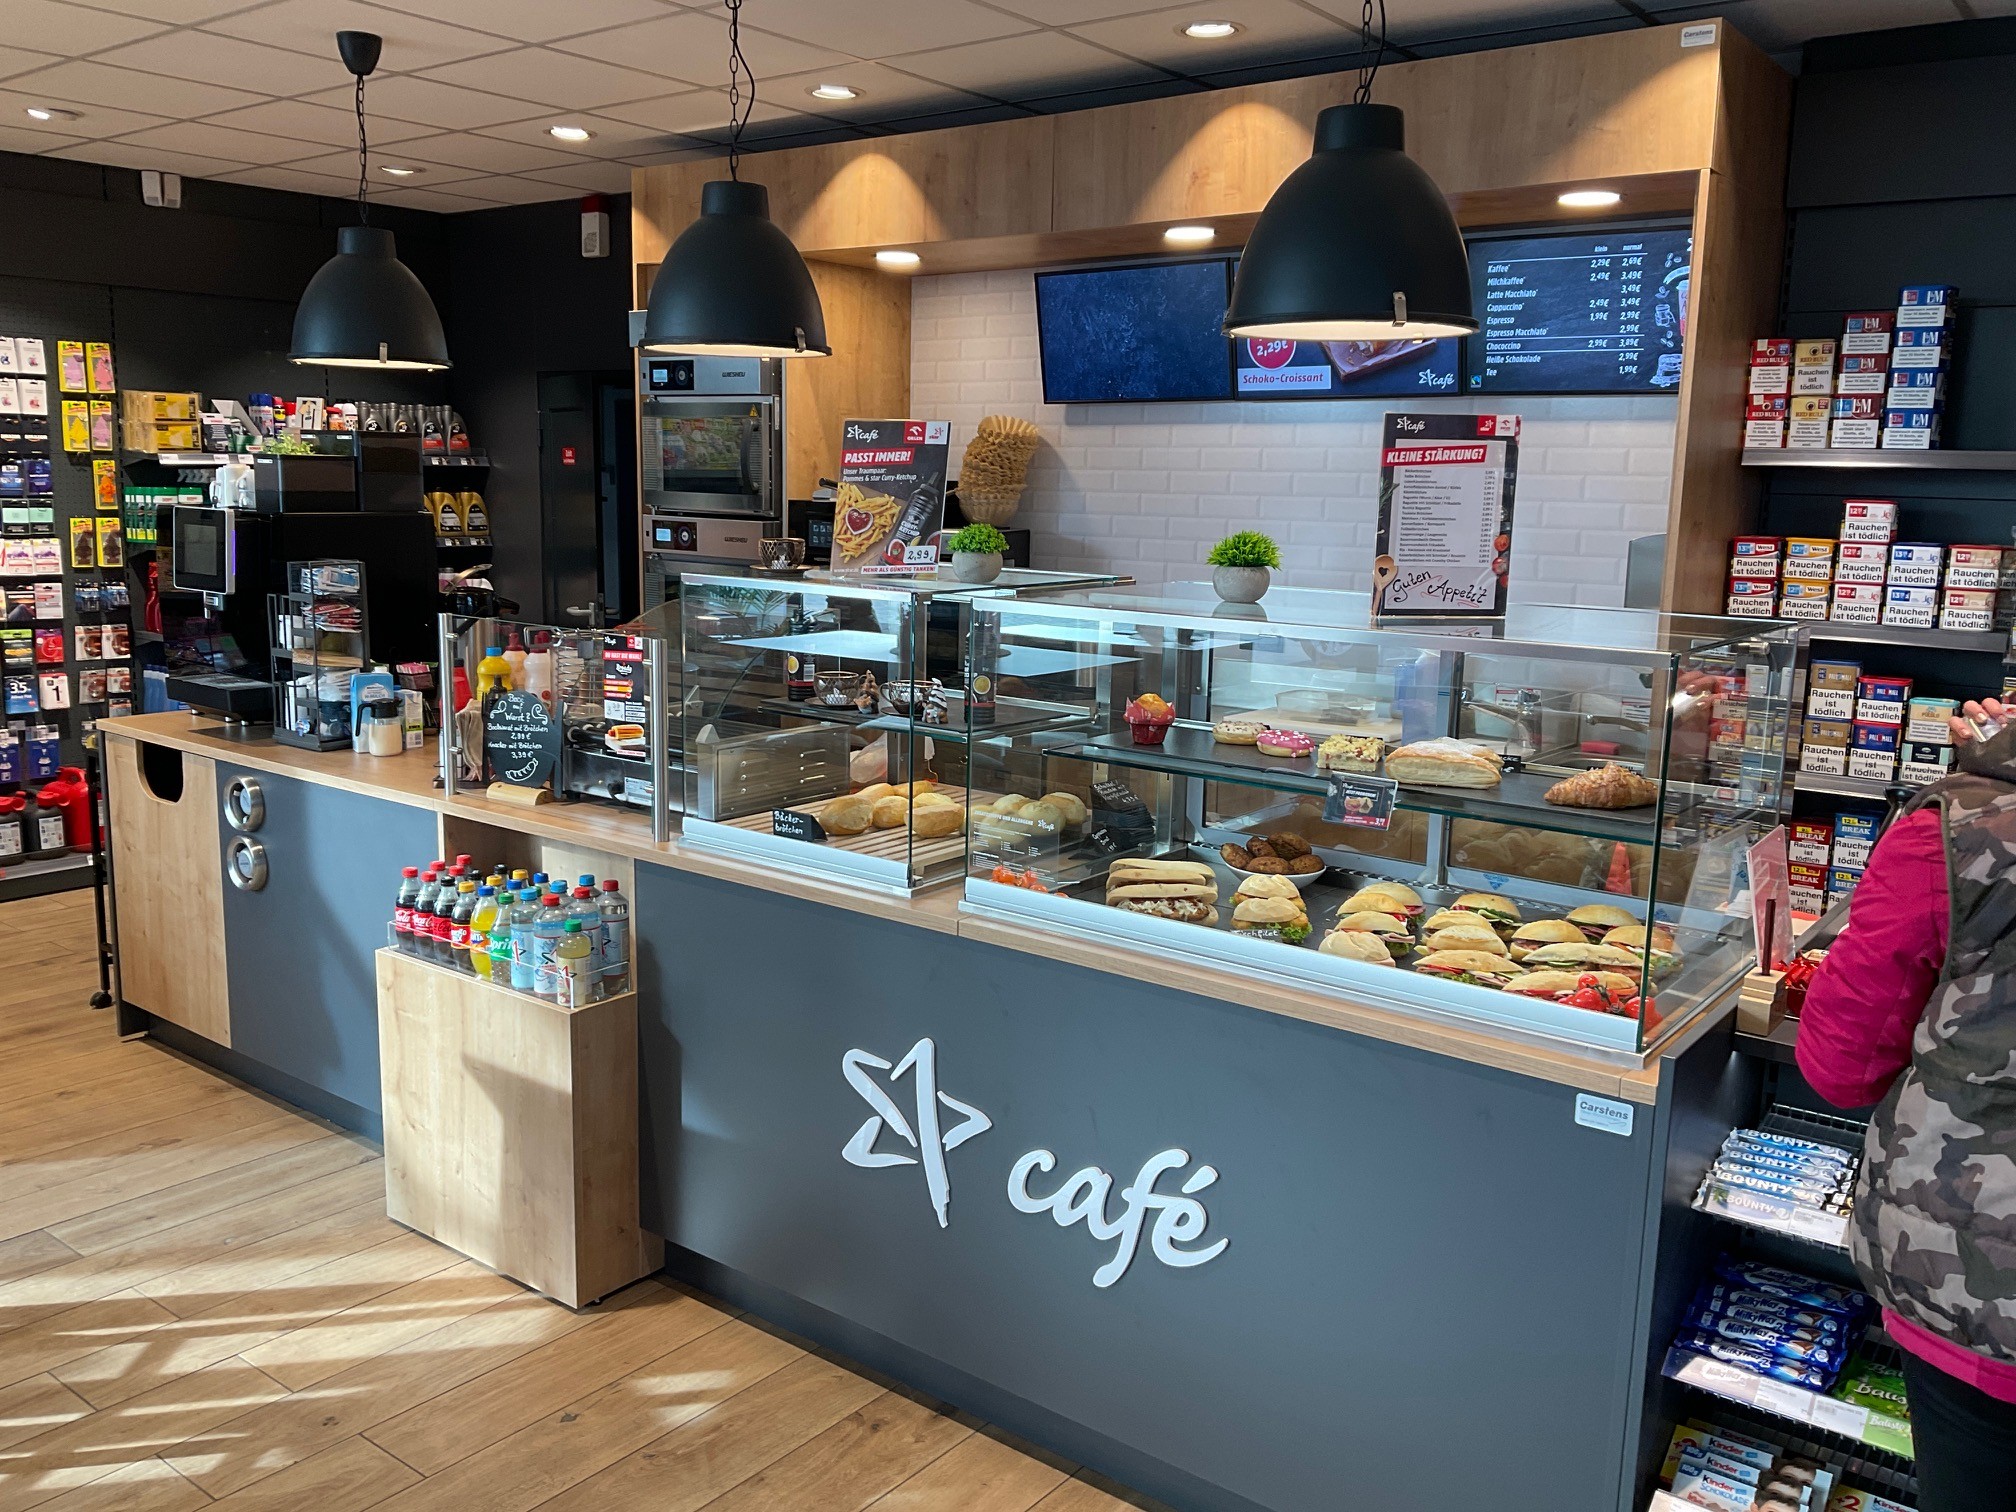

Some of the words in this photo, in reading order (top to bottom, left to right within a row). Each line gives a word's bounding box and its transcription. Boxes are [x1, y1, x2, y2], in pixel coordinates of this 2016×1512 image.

[1591, 258, 1610, 268] 2,29€
[1622, 257, 1642, 266] 2,69€
[1590, 272, 1610, 281] 2,49€
[1487, 290, 1503, 299] Latte
[1621, 284, 1641, 294] 3,49€
[1589, 299, 1609, 308] 2,49€
[1621, 297, 1640, 307] 3,49€
[1487, 316, 1514, 325] Espresso
[1590, 312, 1608, 321] 1,99€
[1620, 311, 1640, 320] 2,99€
[1487, 329, 1514, 338] Espresso
[1620, 325, 1639, 334] 2,99€
[1486, 342, 1521, 350] Chococcino
[1588, 339, 1607, 348] 2,99€
[1619, 338, 1639, 347] 3,89€
[1486, 355, 1504, 364] Heiße
[1505, 354, 1541, 363] Schokolade
[1619, 352, 1638, 361] 2,99€
[1486, 368, 1497, 376] Tee
[1619, 366, 1637, 375] 1,99€
[1243, 373, 1324, 384] Schoko-Croissant
[1433, 372, 1455, 388] café
[1408, 421, 1425, 433] café
[860, 430, 879, 442] café
[845, 453, 874, 463] PASST
[875, 451, 911, 462] IMMER!
[1387, 451, 1423, 463] KLEINE
[1424, 448, 1483, 461] STÄRKUNG?
[1849, 523, 1887, 531] Rauchen
[1858, 532, 1888, 540] tödlich
[1790, 561, 1827, 569] Rauchen
[1842, 564, 1881, 572] Rauchen
[1894, 566, 1934, 575] Rauchen
[1746, 568, 1775, 576] tödlich
[1799, 570, 1828, 578] tödlich
[1852, 573, 1882, 581] tödlich
[1953, 569, 1995, 577] Rauchen
[1904, 576, 1935, 584] tödlich
[1964, 579, 1996, 587] tödlich
[1393, 571, 1432, 602] Guten
[1427, 579, 1487, 603] Appetit
[1786, 601, 1823, 609] Rauchen
[1837, 604, 1875, 612] Rauchen
[1742, 607, 1771, 615] tödlich
[1794, 610, 1824, 618] tödlich
[1889, 607, 1929, 616] Rauchen
[1948, 611, 1989, 619] Rauchen
[1846, 613, 1876, 621] tödlich
[1899, 617, 1930, 625] tödlich
[1959, 621, 1990, 629] tödlich
[1812, 690, 1852, 700] Rauchen
[1814, 707, 1845, 717] tödlich
[1861, 702, 1899, 712] Rauchen
[1871, 711, 1900, 720] tödlich
[487, 723, 513, 731] Bockwurst
[524, 724, 548, 732] Brötchen
[1804, 745, 1844, 756] Rauchen
[1852, 750, 1893, 761] Rauchen
[1806, 764, 1837, 774] tödlich
[1854, 768, 1886, 779] tödlich
[774, 810, 803, 823] Bäcker-
[775, 823, 803, 834] brötchen
[1842, 826, 1870, 834] BREAK
[1796, 833, 1824, 841] BREAK
[1791, 875, 1819, 884] BREAK
[1580, 1101, 1628, 1120] Carstens
[1748, 1130, 1819, 1149] BOUNTY
[1738, 1142, 1809, 1162] BOUNTY
[1729, 1150, 1800, 1170] BOUNTY
[1729, 1163, 1801, 1181] BOUNTY
[1722, 1172, 1793, 1194] BOUNTY
[1726, 1195, 1774, 1213] BOUNTY
[1007, 1148, 1230, 1289] café
[1869, 1415, 1904, 1430] Balisto
[1709, 1437, 1744, 1455] kinder
[1707, 1457, 1738, 1474] kinder
[1702, 1475, 1734, 1491] kinder
[1700, 1483, 1749, 1506] SCHOKOLADE
